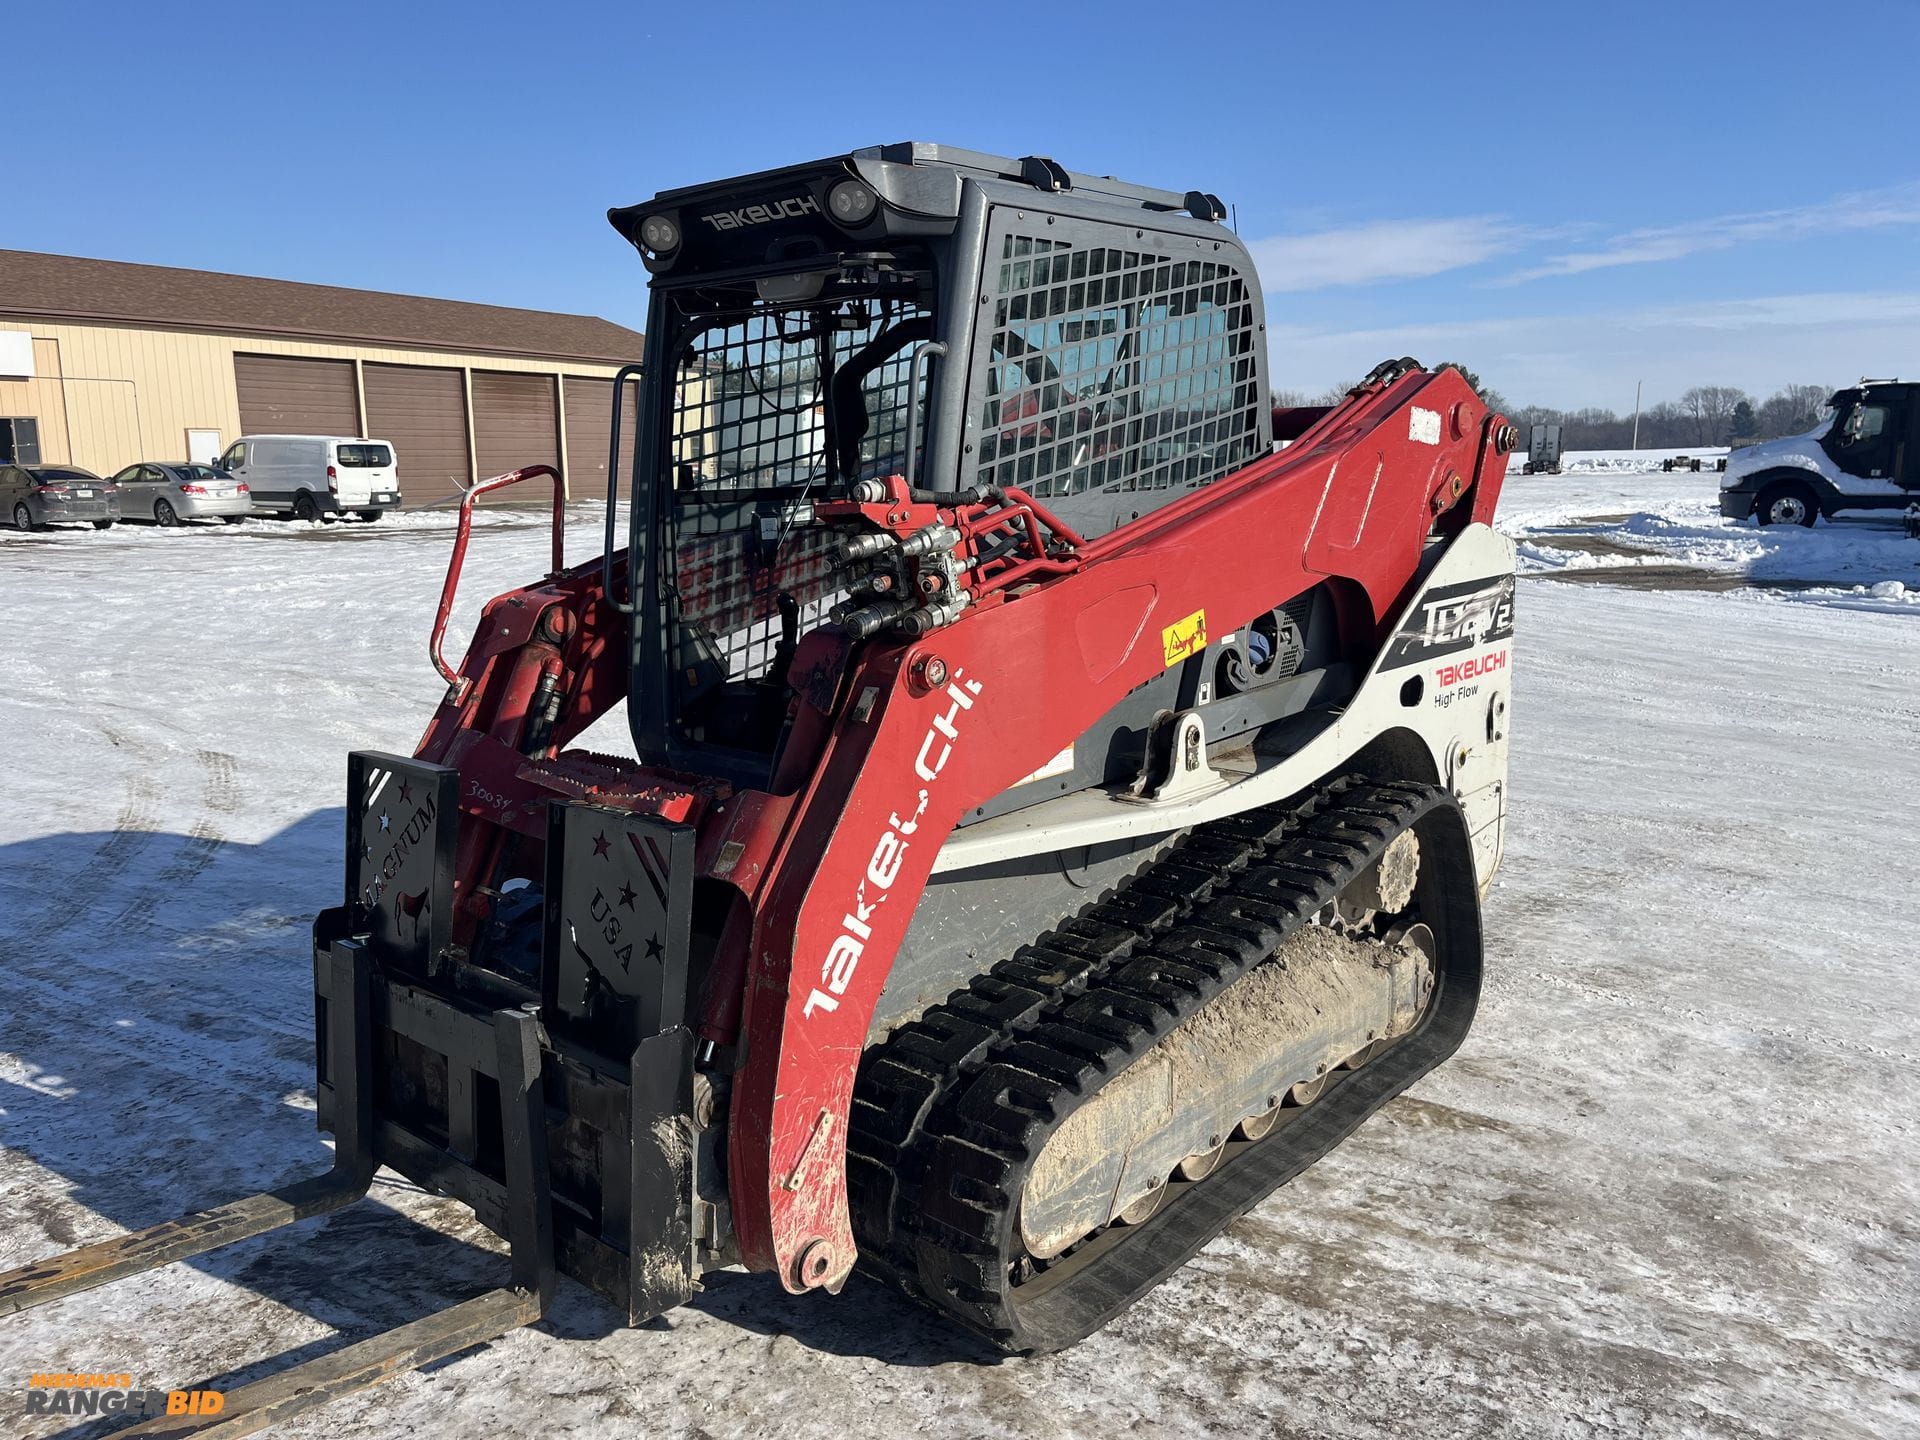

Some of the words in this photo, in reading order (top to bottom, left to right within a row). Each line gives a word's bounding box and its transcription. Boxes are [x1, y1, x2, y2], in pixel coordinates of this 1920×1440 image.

[701, 195, 821, 231] TAKEUCH
[1434, 690, 1455, 708] High
[1457, 685, 1479, 701] Flow
[363, 791, 437, 911] MAGNUM
[590, 886, 633, 976] USA
